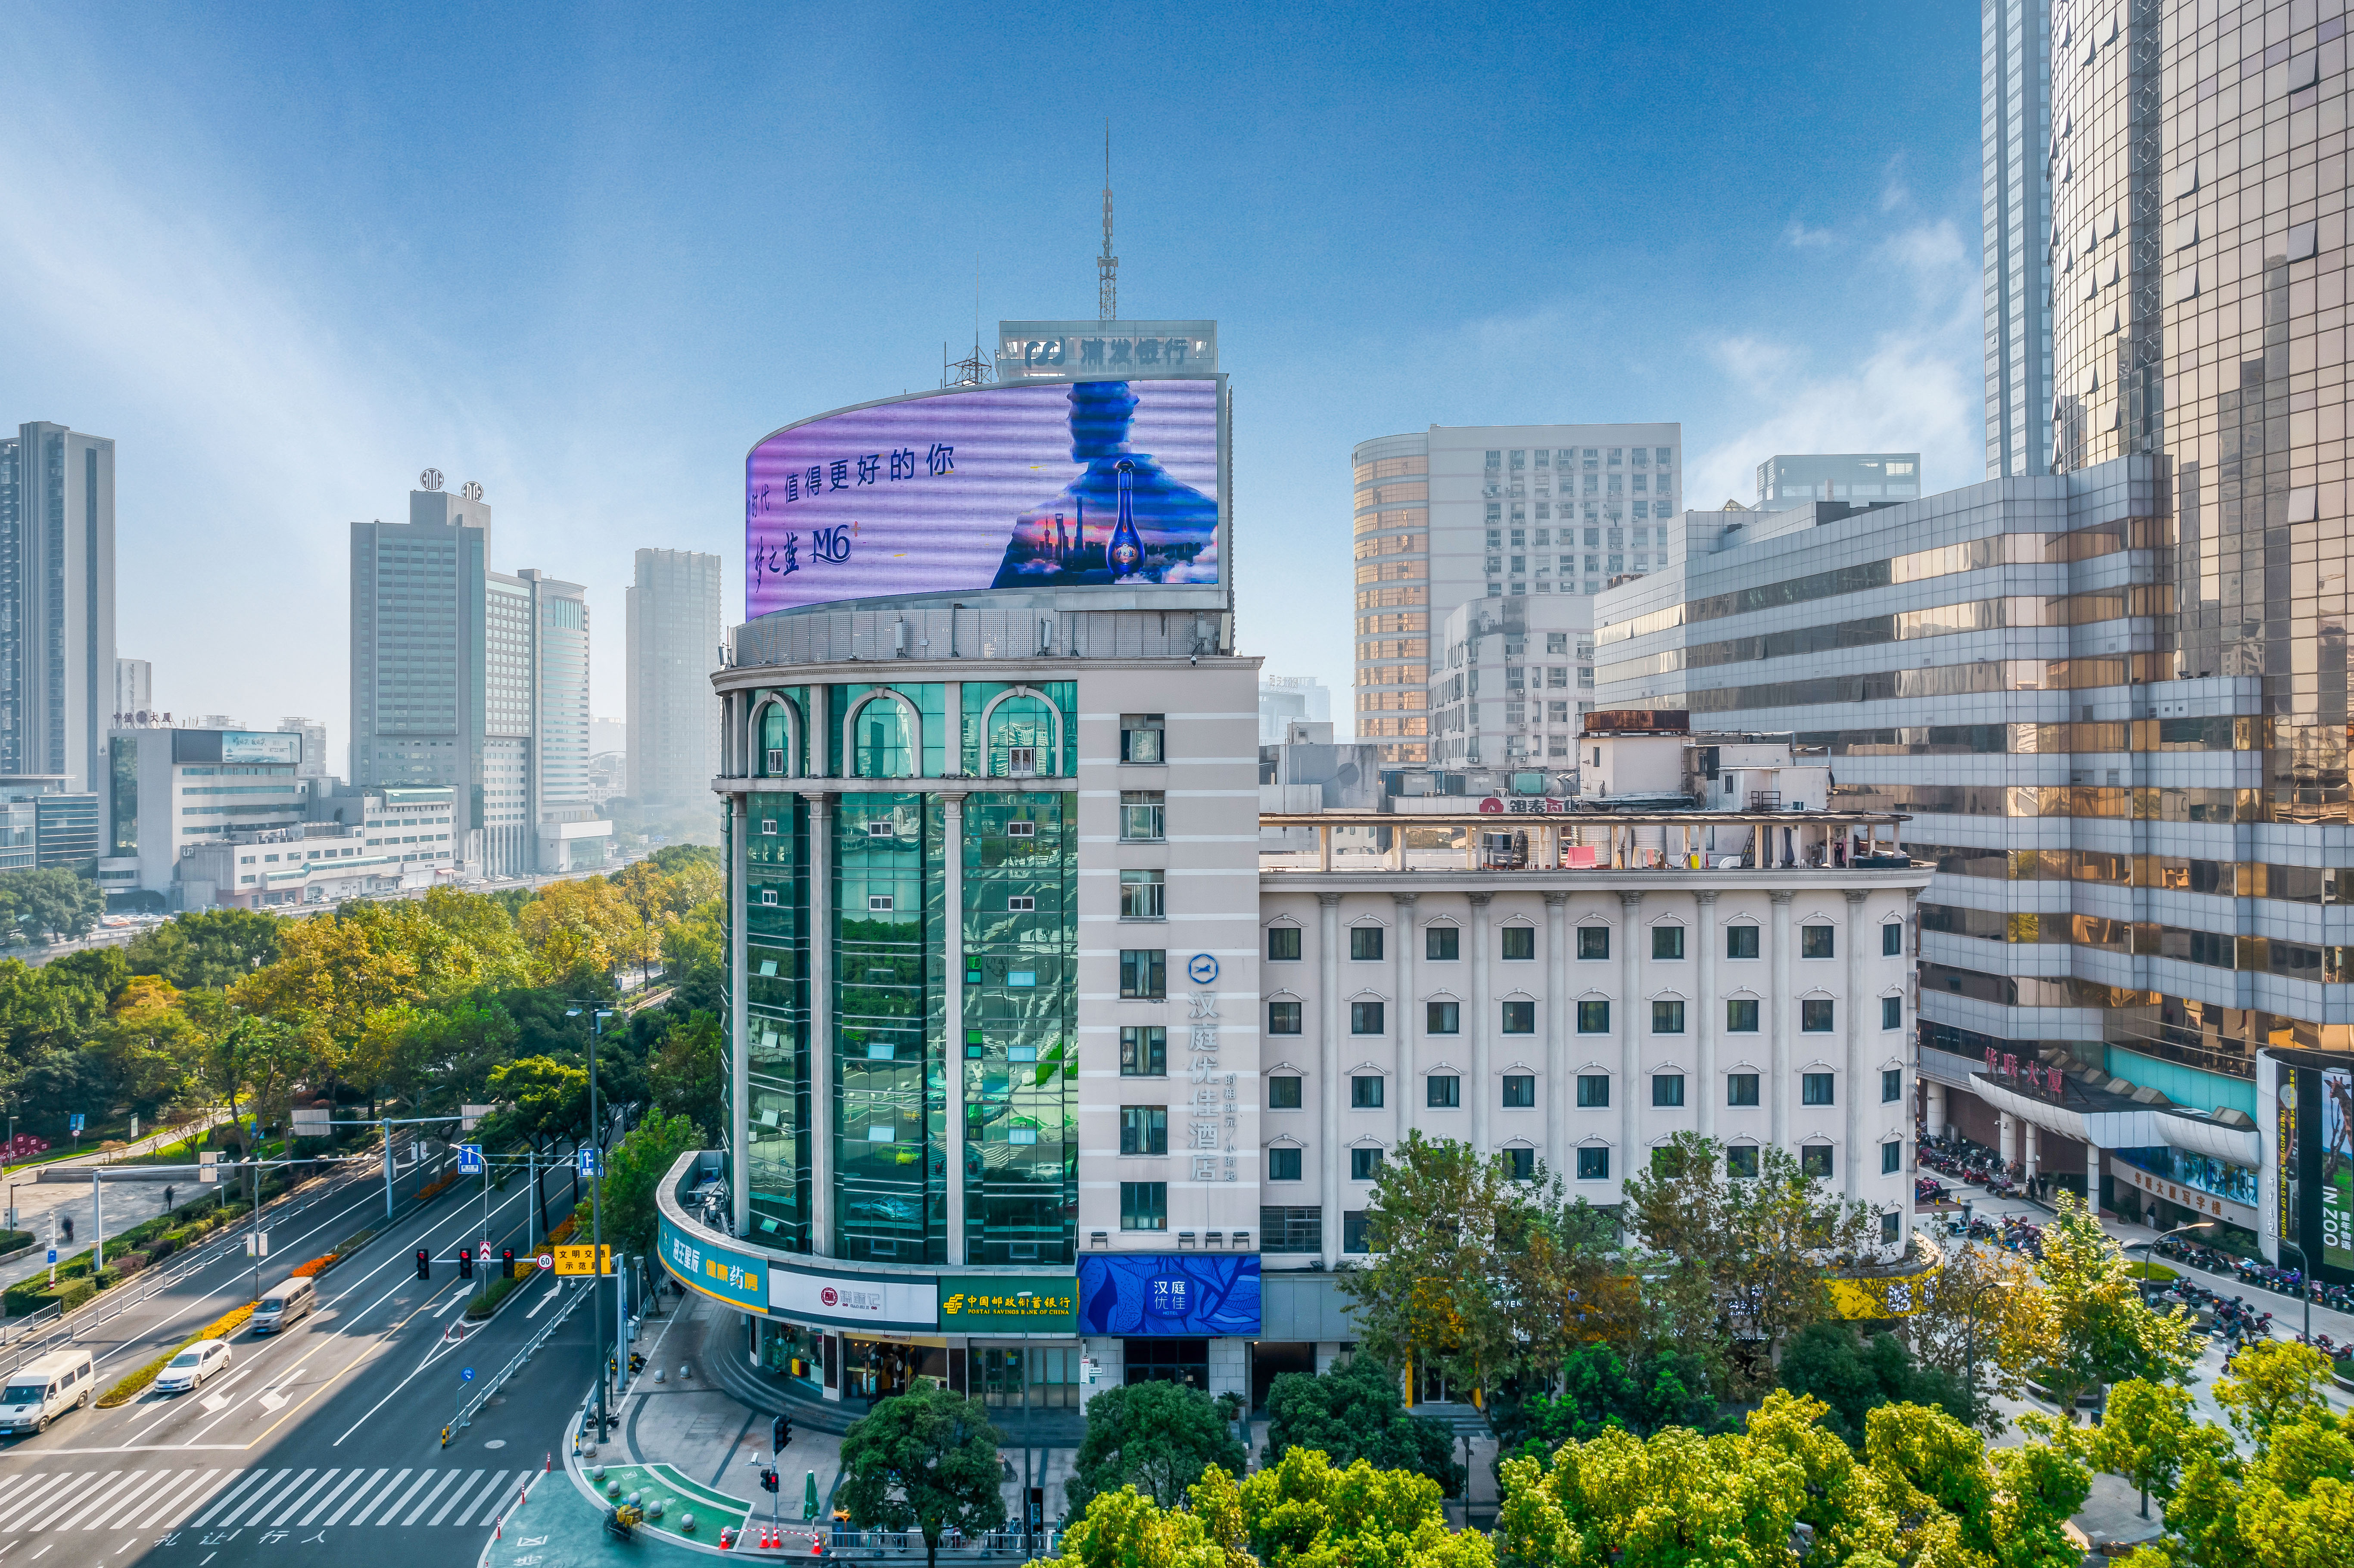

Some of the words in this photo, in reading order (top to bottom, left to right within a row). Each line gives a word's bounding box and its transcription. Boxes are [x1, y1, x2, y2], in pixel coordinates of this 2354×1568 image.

[1081, 337, 1189, 366] 浦发银行
[785, 443, 954, 504] 值得更好的你
[755, 532, 800, 594] 梦之蓝
[1188, 991, 1219, 1182] 汉庭优佳酒店
[1985, 1046, 2063, 1093] 华联大厦
[1224, 1073, 1238, 1182] 时租80元/小时起
[2281, 1198, 2286, 1209] OF
[673, 1237, 700, 1273] 海王星辰
[706, 1259, 758, 1291] 健康药房
[967, 1294, 1071, 1309] 中国邮政储蓄银行
[1154, 1281, 1186, 1294] 汉庭
[1154, 1296, 1186, 1310] 优佳
[153, 1529, 326, 1548] 礼让行人
